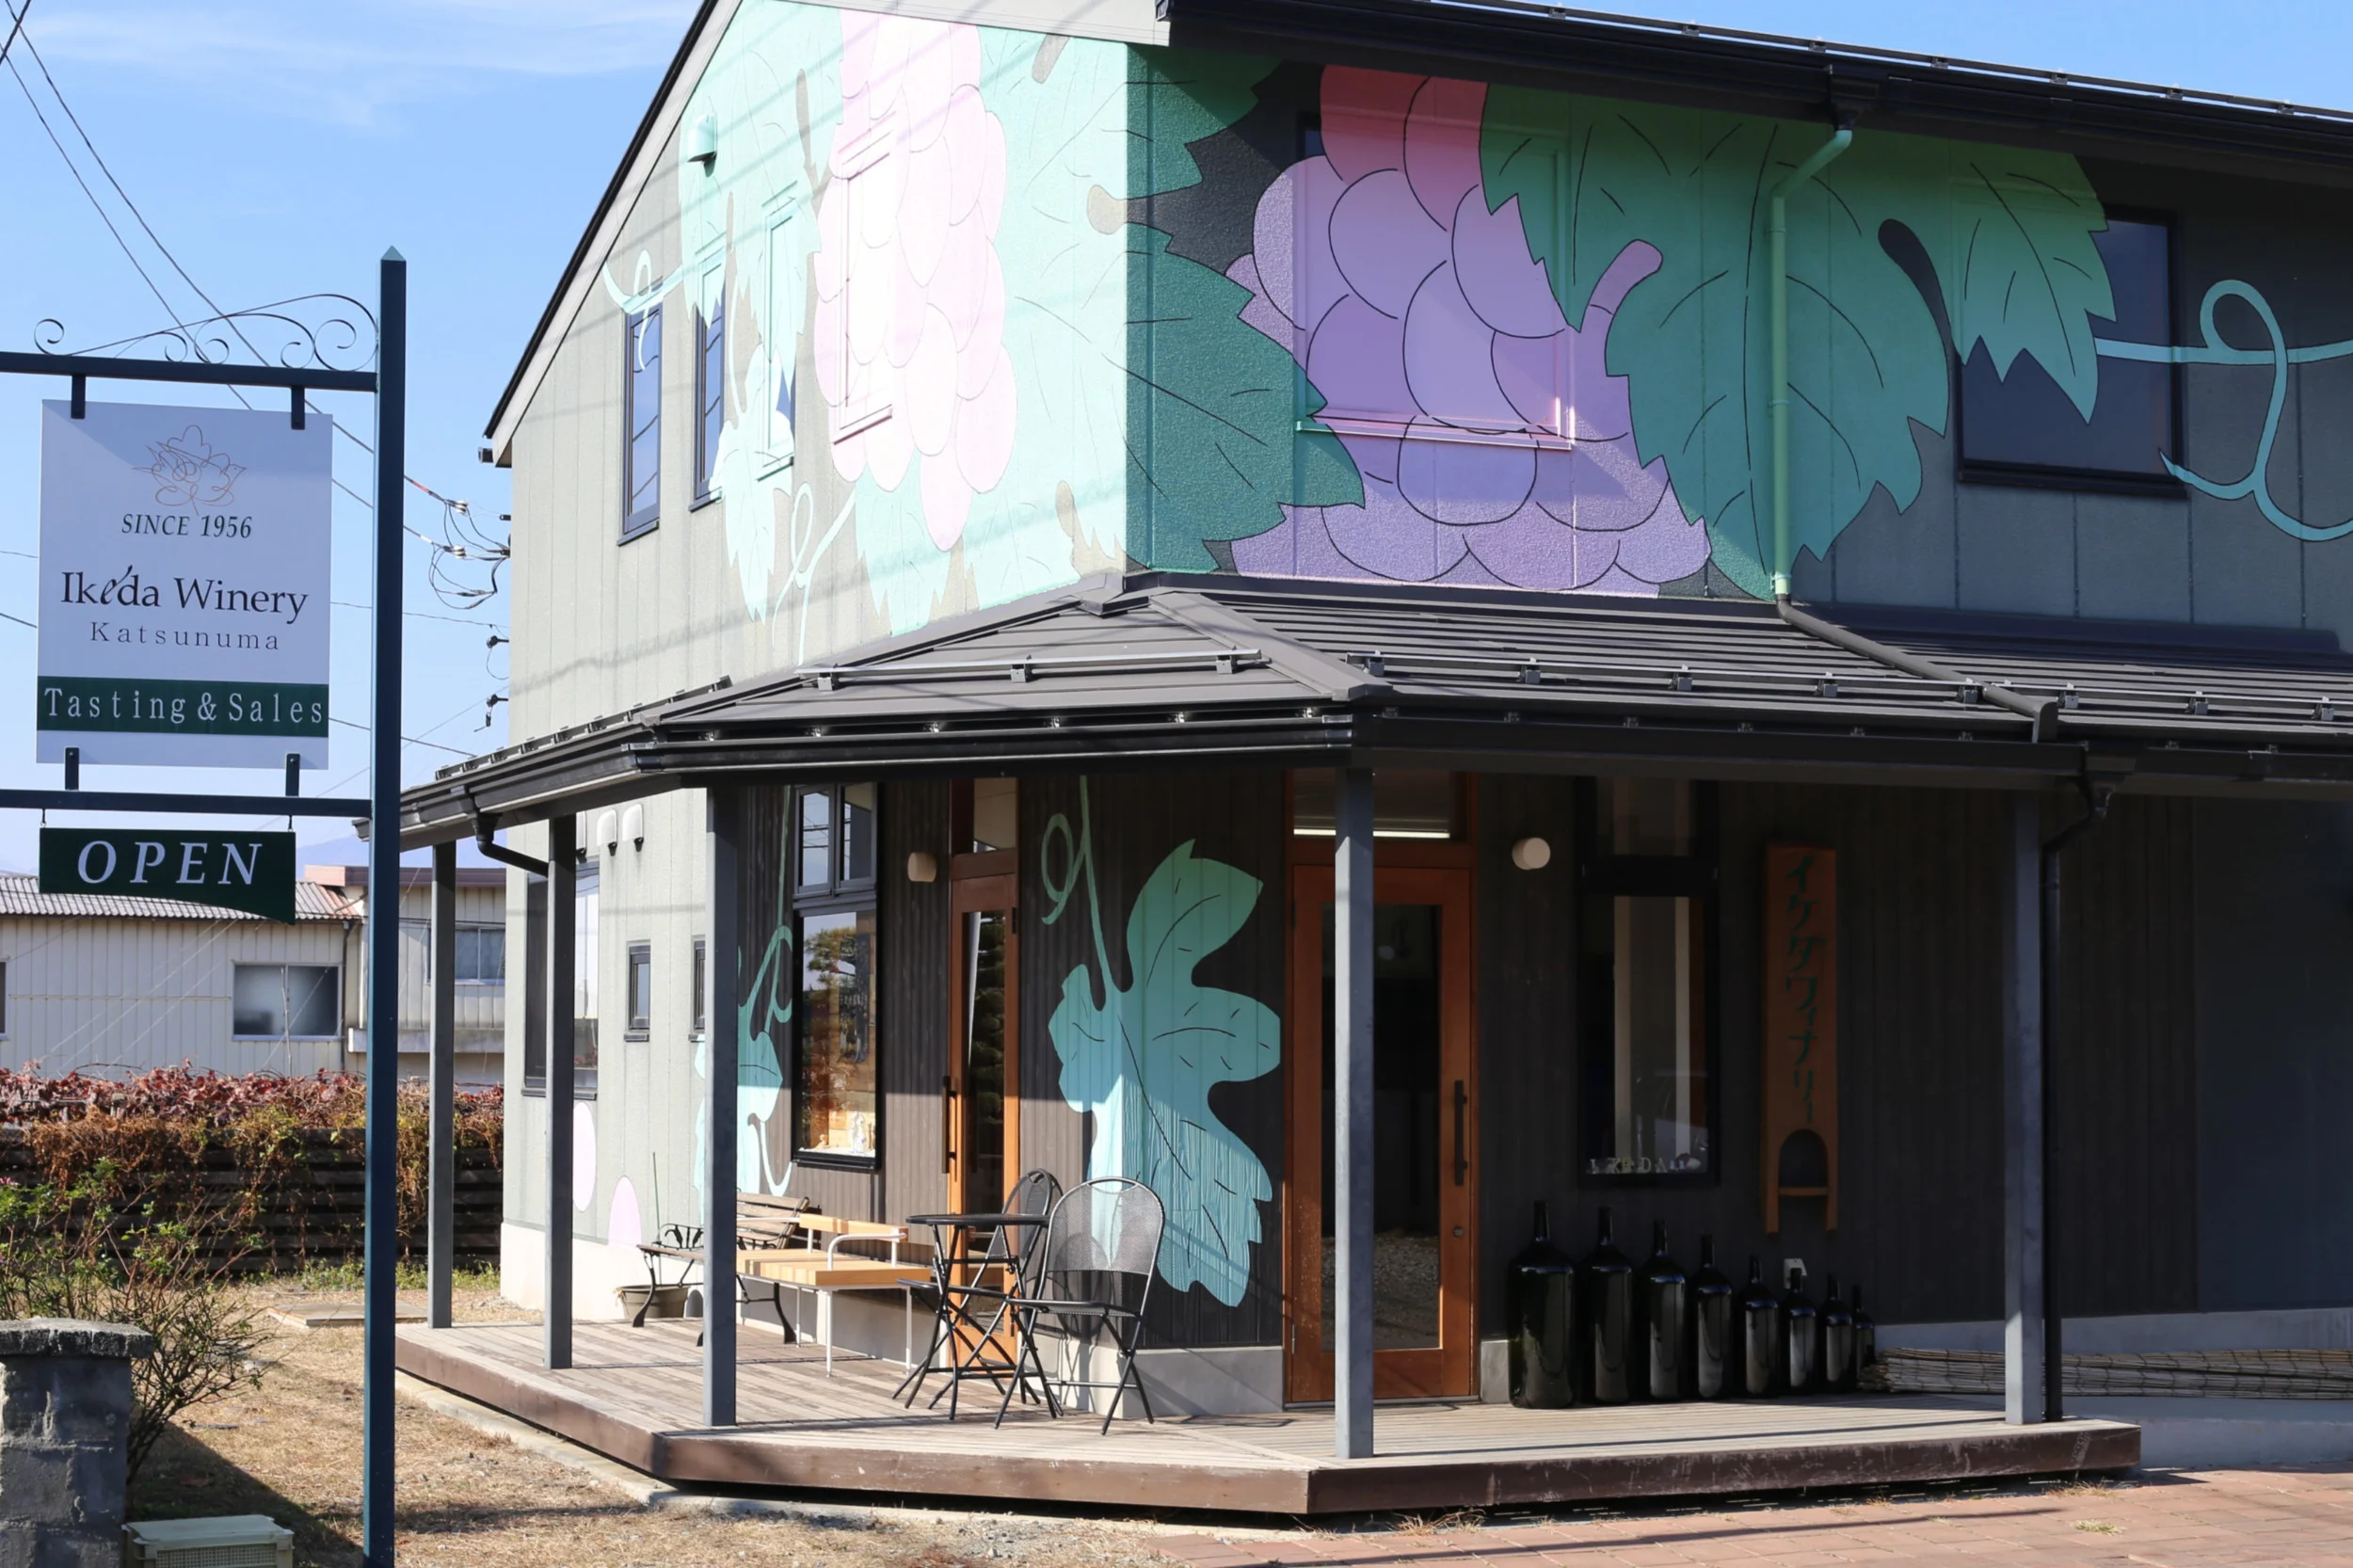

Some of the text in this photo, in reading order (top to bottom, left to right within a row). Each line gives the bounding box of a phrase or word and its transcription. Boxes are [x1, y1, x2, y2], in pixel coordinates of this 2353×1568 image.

[121, 513, 252, 538] SINCE 1956
[173, 577, 309, 624] Winery
[90, 621, 280, 650] Katsunuma
[44, 687, 323, 724] Tasting & Sales
[77, 840, 263, 886] OPEN
